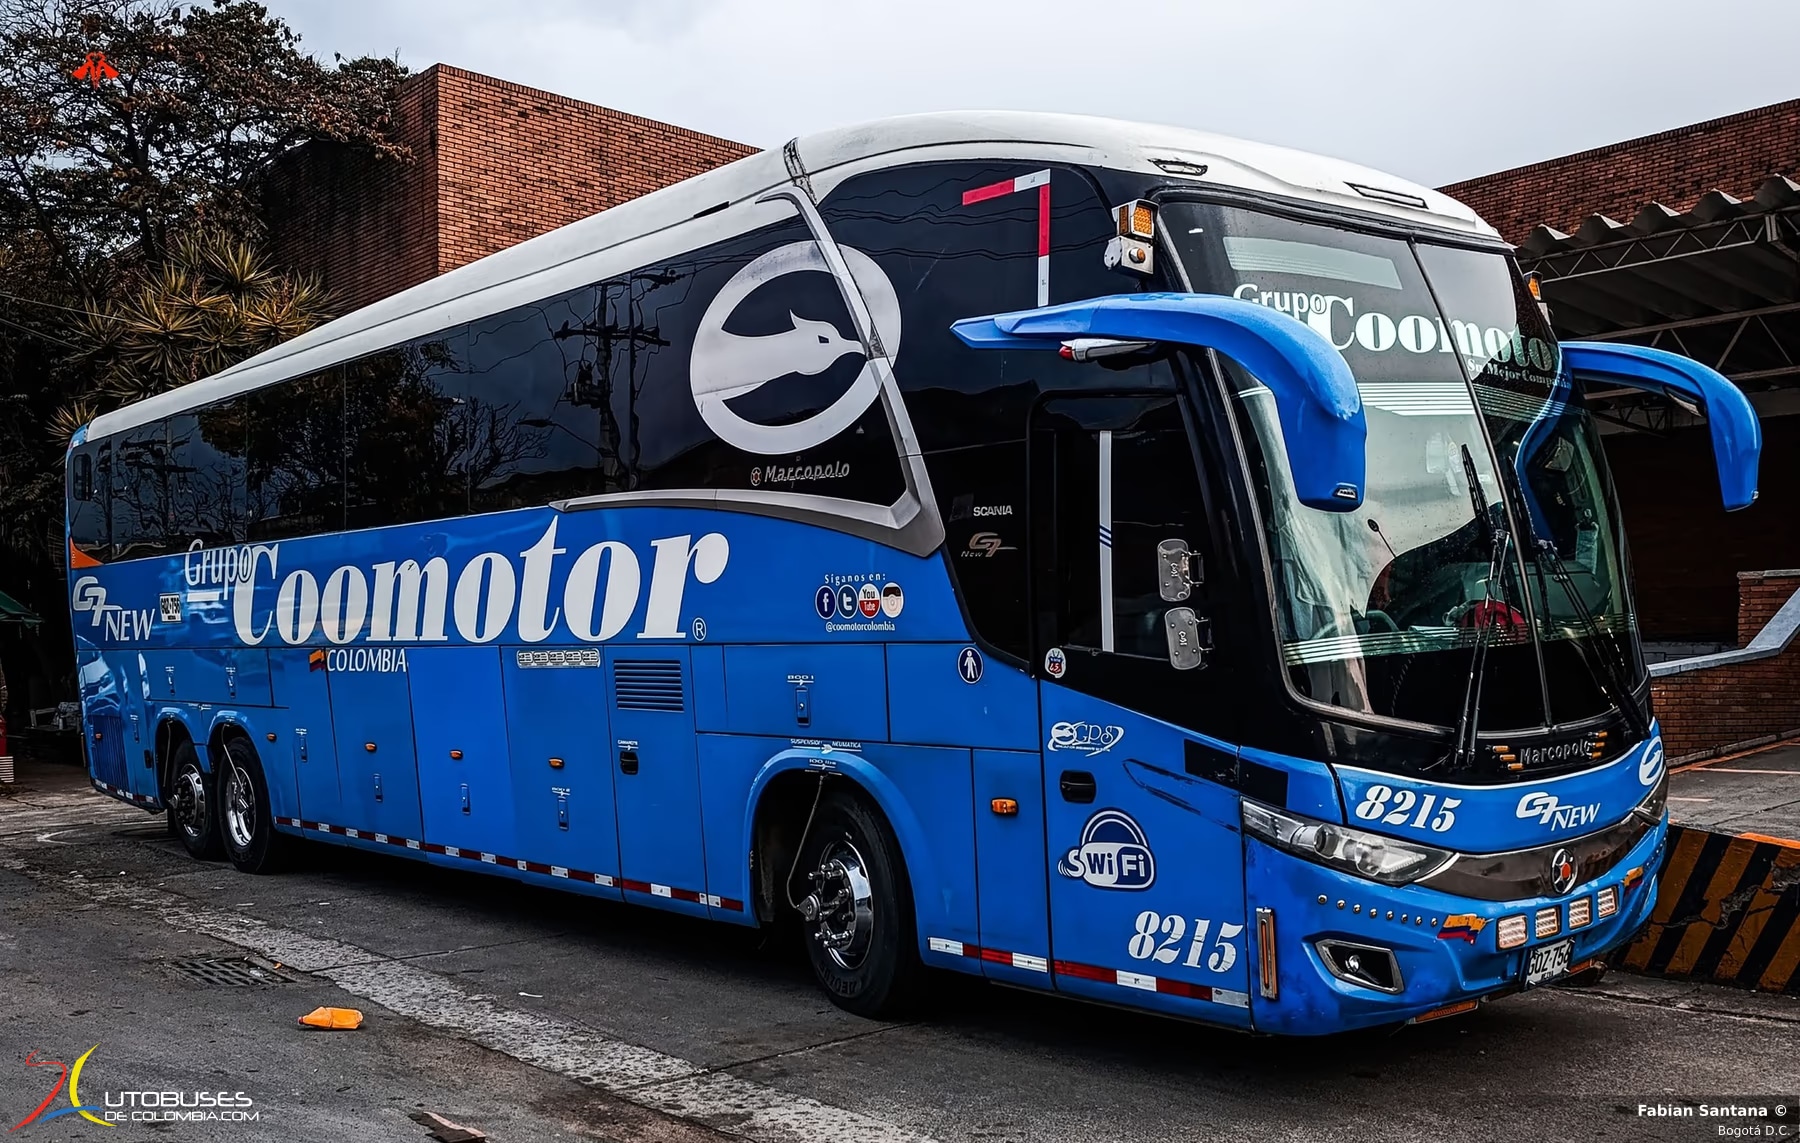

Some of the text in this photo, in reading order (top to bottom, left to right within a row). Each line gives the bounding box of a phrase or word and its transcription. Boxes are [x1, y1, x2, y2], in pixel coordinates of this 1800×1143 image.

[1233, 283, 1559, 372] Grupo Coomoto
[1486, 362, 1521, 382] Mejor
[764, 460, 850, 483] Marcopolo
[973, 505, 1013, 517] SCANIA
[184, 538, 254, 601] Grupo
[233, 514, 730, 646] Coomotor
[824, 572, 886, 586] Síganos en:
[862, 588, 876, 599] You
[863, 601, 876, 611] Tube
[105, 608, 156, 642] NEW
[825, 620, 896, 633] @coomotorcolombia
[327, 647, 407, 673] COLOMBIA
[1074, 723, 1114, 745] GPS
[1520, 739, 1592, 765] Marcopolo
[1355, 784, 1463, 832] 8215
[1550, 802, 1601, 832] NEW
[1127, 910, 1243, 973] 8215
